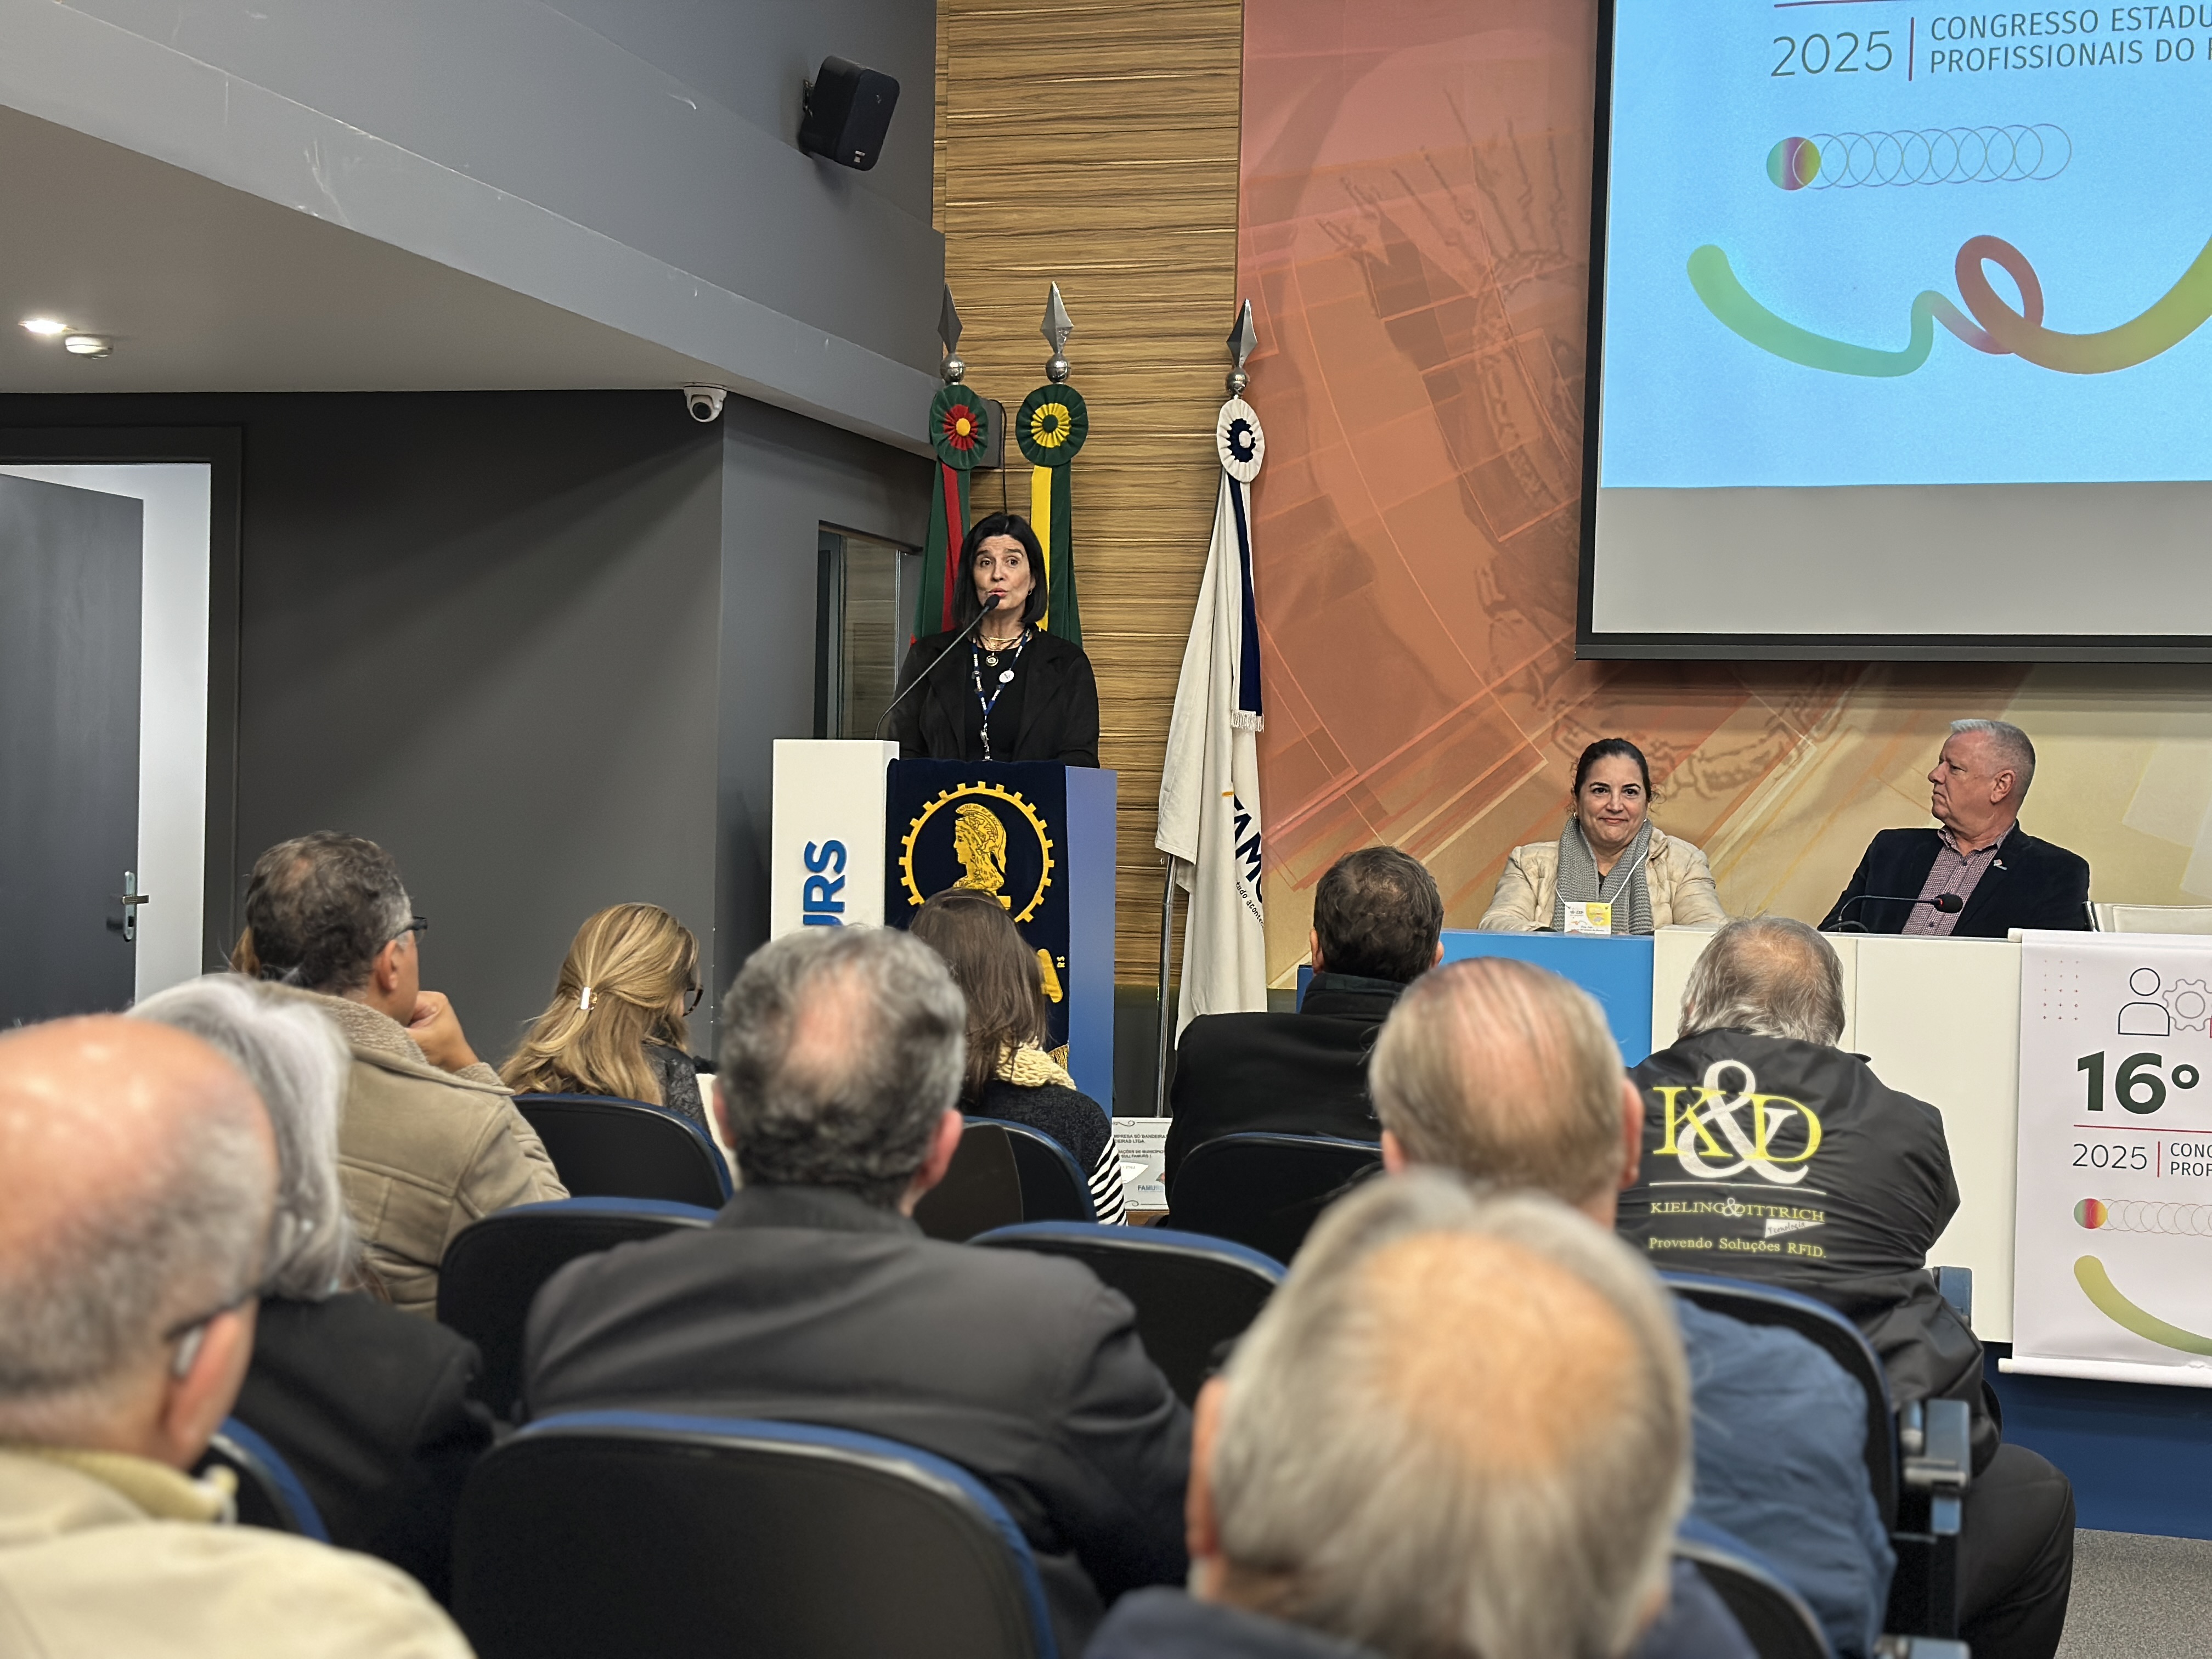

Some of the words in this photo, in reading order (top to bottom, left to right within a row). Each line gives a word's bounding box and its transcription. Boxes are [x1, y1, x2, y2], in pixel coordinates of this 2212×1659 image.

[1931, 10, 2098, 41] CONGRESSO
[2112, 4, 2212, 31] ESTADU
[1771, 31, 1893, 76] 2025
[1931, 40, 2143, 73] PROFISSIONAIS
[2155, 38, 2194, 63] DO
[1235, 881, 1248, 899] tudo
[1056, 956, 1065, 968] RS
[2072, 1143, 2147, 1170] 2025
[2170, 1161, 2212, 1177] PROF
[1649, 1237, 1713, 1249] Provendo
[1719, 1238, 1780, 1252] Soluções
